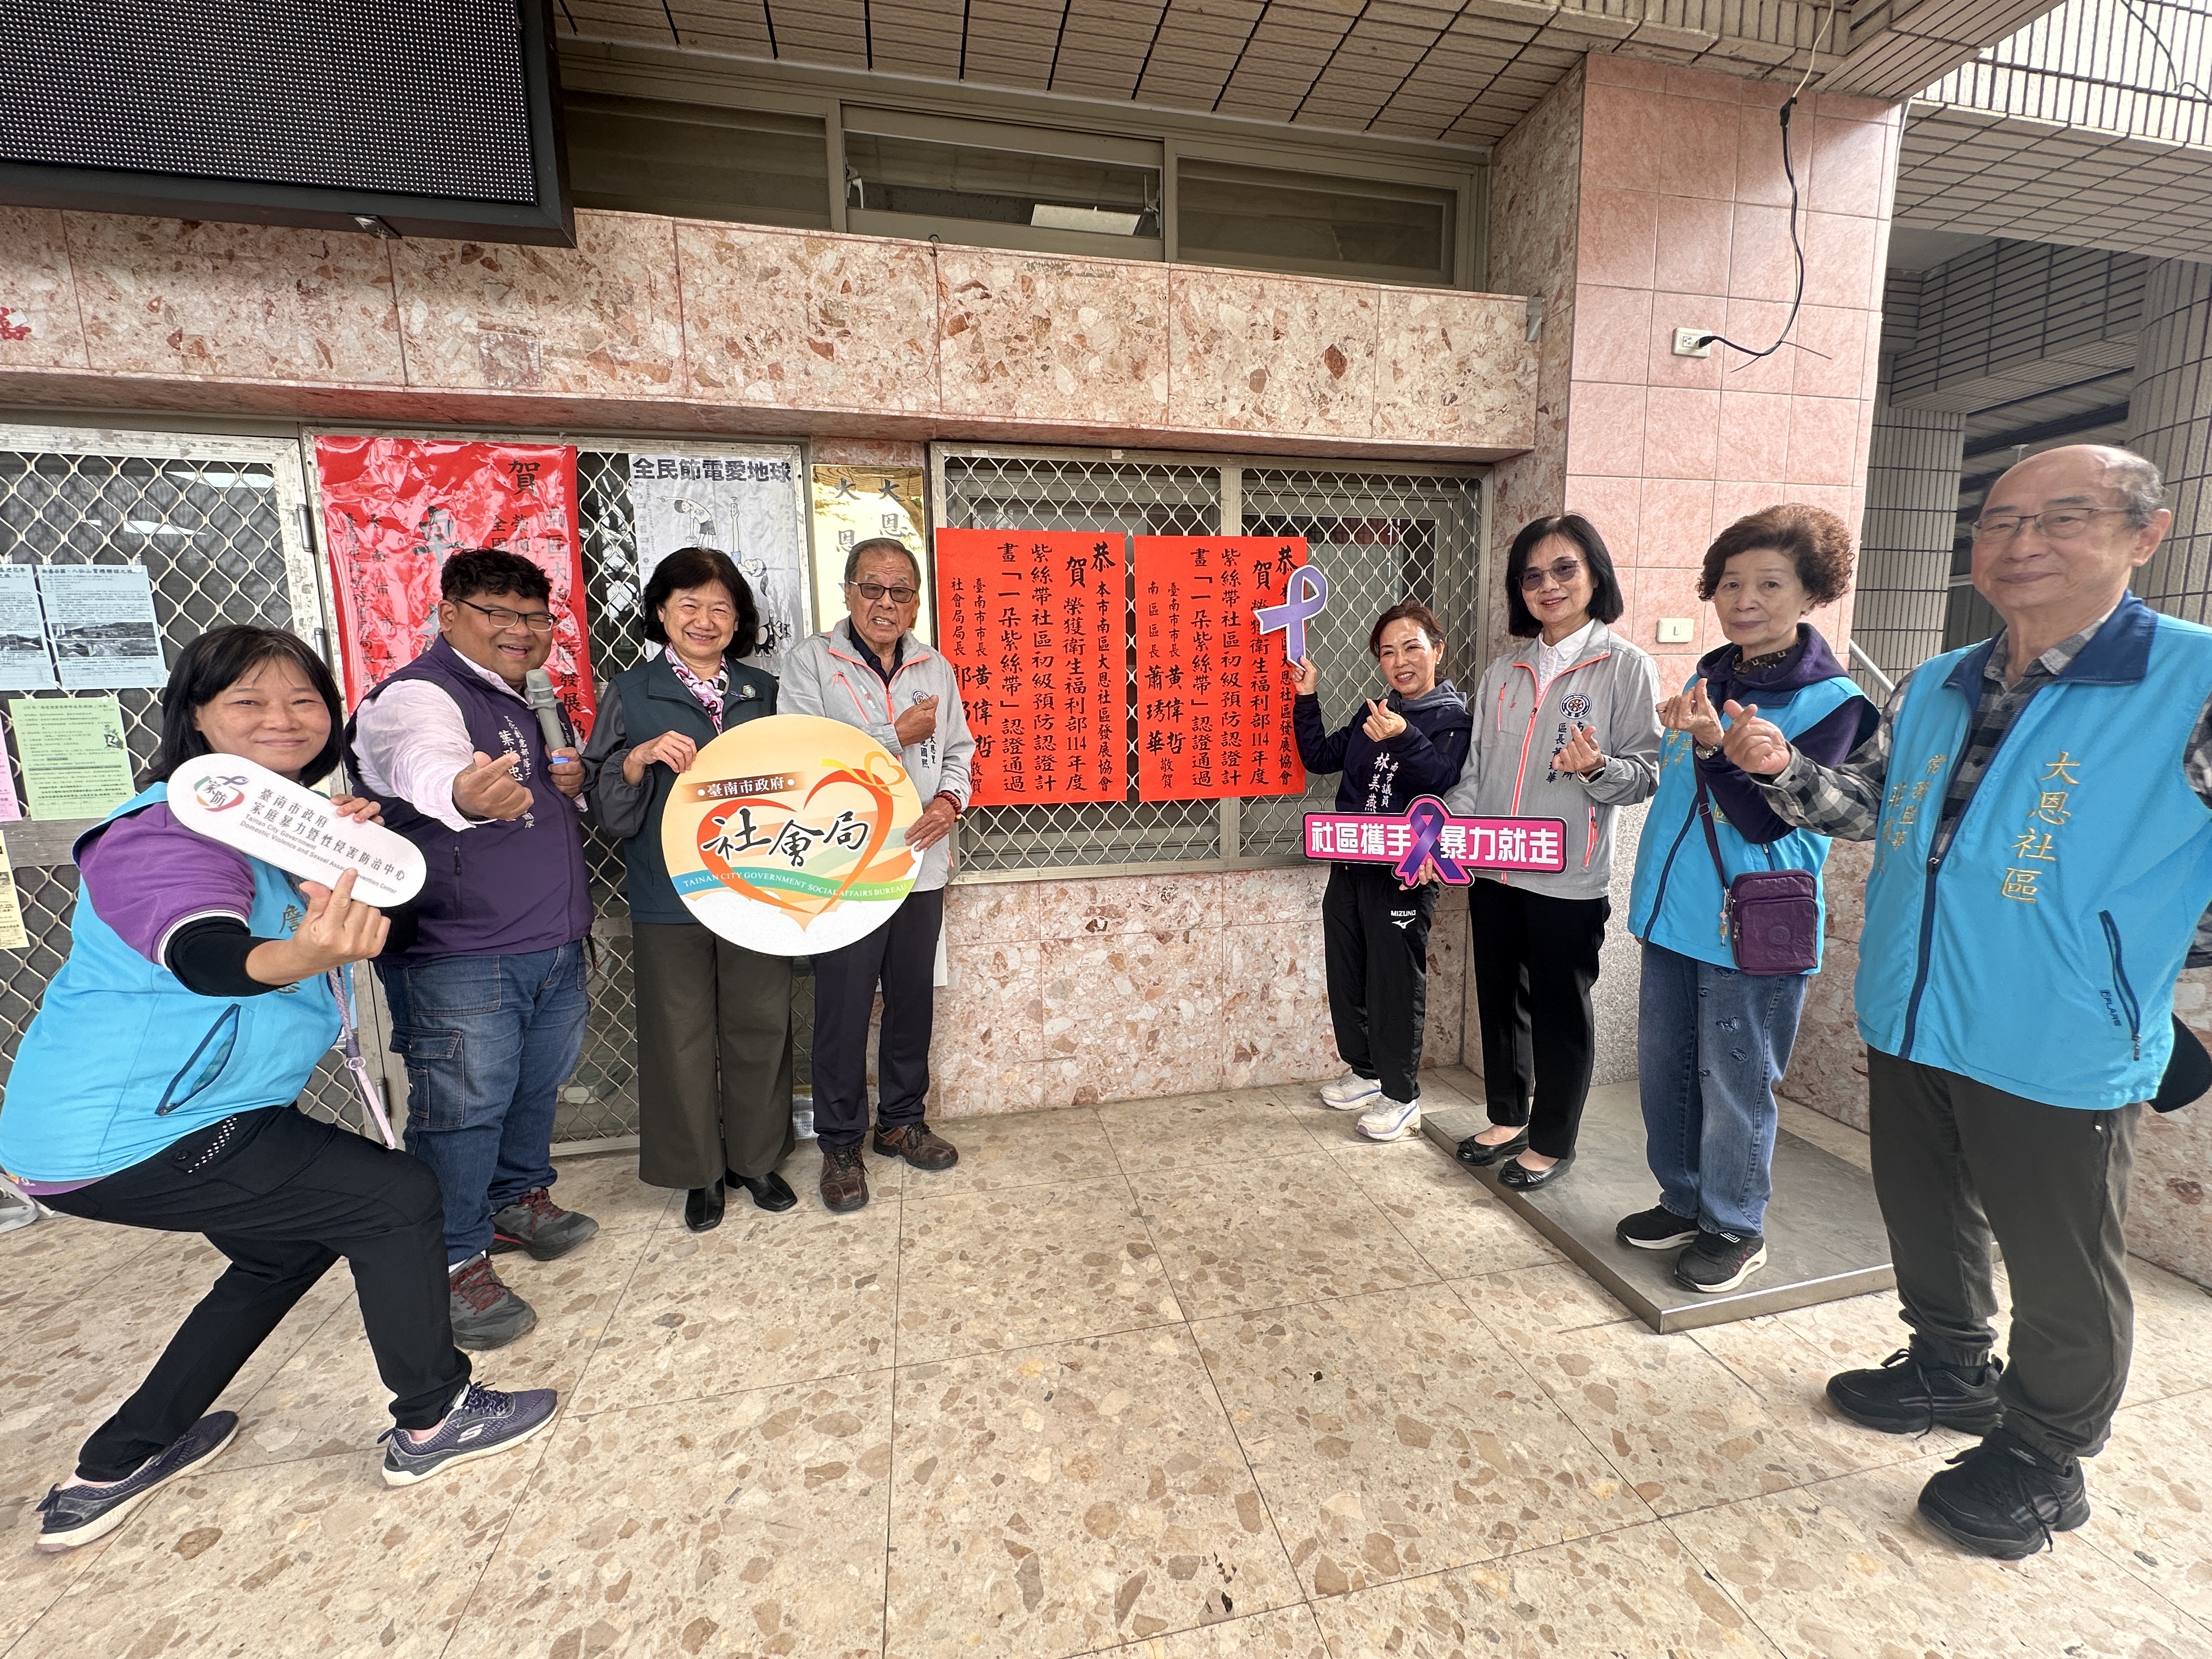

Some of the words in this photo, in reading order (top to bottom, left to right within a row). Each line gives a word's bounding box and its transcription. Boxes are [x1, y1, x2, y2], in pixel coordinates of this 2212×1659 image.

[508, 459, 540, 495] 賀
[633, 458, 793, 483] 全民節電愛地球
[1066, 555, 1088, 589] 賀
[1090, 540, 1117, 573] 恭
[1252, 559, 1273, 591] 賀
[1274, 544, 1299, 575] 恭
[951, 577, 966, 657] 社會局局長
[973, 578, 988, 657] 臺南市市長
[1147, 580, 1161, 659] 南區區長
[1168, 582, 1181, 658] 臺南市市長
[1030, 543, 1057, 792] 紫絲帶社區初級預防認證計
[1063, 596, 1087, 792] 榮獲衛生福利部114年度
[1096, 580, 1113, 792] 本市南區大恩社區發展協會
[1220, 548, 1242, 786] 紫絲帶社區初級預防認證計
[971, 664, 996, 759] 黃偉哲
[1144, 664, 1167, 757] 蕭琇華
[1164, 664, 1186, 755] 黃偉哲
[202, 780, 229, 807] 家防
[707, 776, 785, 798] 臺南市政府
[1160, 757, 1175, 789] 敬賀
[1364, 752, 1390, 812] 林美燕
[245, 814, 266, 827] Tainan
[267, 824, 279, 833] City
[280, 830, 317, 850] Government
[258, 788, 329, 828] 臺南市政府
[702, 808, 868, 868] 社會局
[1999, 751, 2081, 904] 大恩社區
[240, 820, 270, 838] Domestic
[271, 834, 297, 849] Violence
[297, 847, 309, 855] and
[309, 851, 329, 864] Sexual
[380, 882, 397, 894] Center
[250, 802, 405, 881] 家庭暴力暨性侵害防治中心
[1311, 821, 1412, 856] 社區攜手
[1440, 825, 1559, 864] 暴力就走
[683, 874, 719, 888] TAINAN
[720, 872, 743, 881] CITY
[744, 872, 807, 889] GOVERNMENT
[808, 883, 838, 896] SOCIAL
[874, 883, 907, 896] BUREAU
